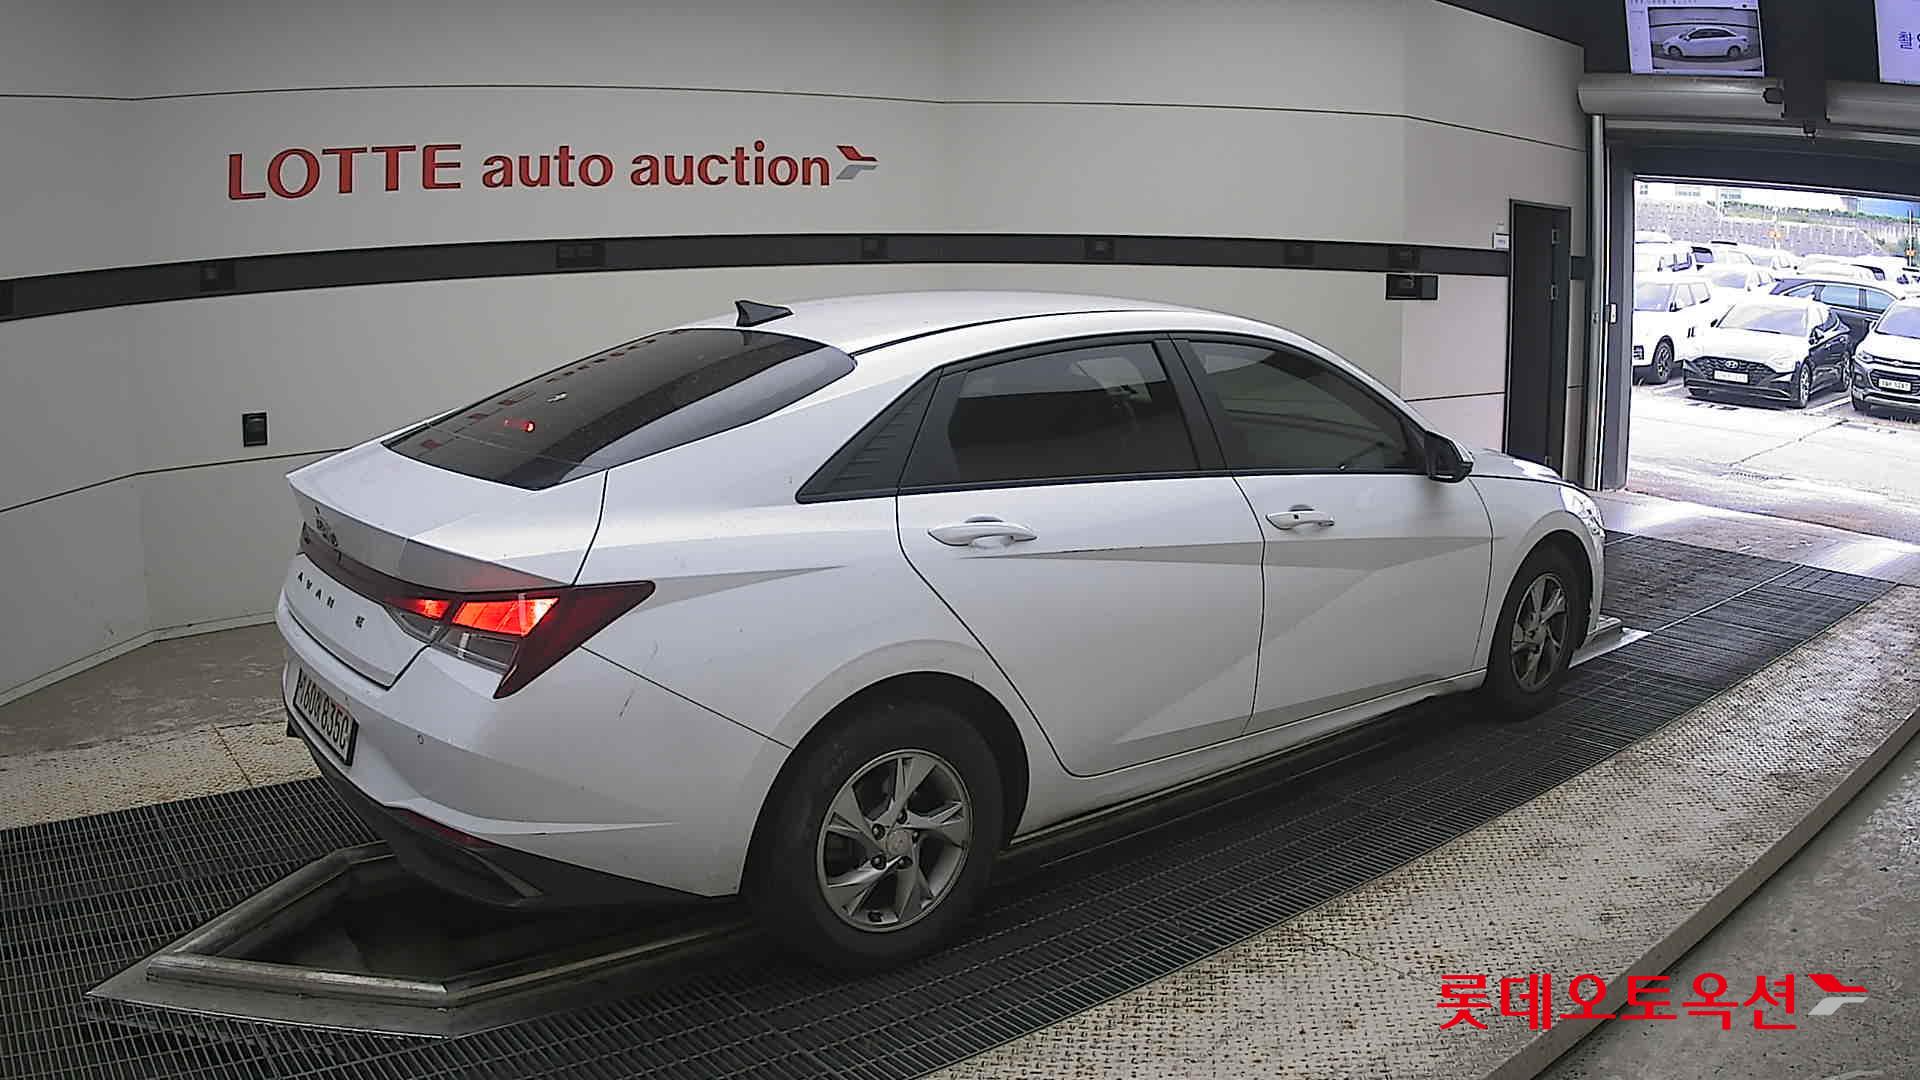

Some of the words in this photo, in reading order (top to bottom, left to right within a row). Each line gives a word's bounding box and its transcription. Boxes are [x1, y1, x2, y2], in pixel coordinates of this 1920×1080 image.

[227, 143, 462, 201] LOTTE
[481, 145, 614, 188] auto
[629, 140, 830, 187] auction
